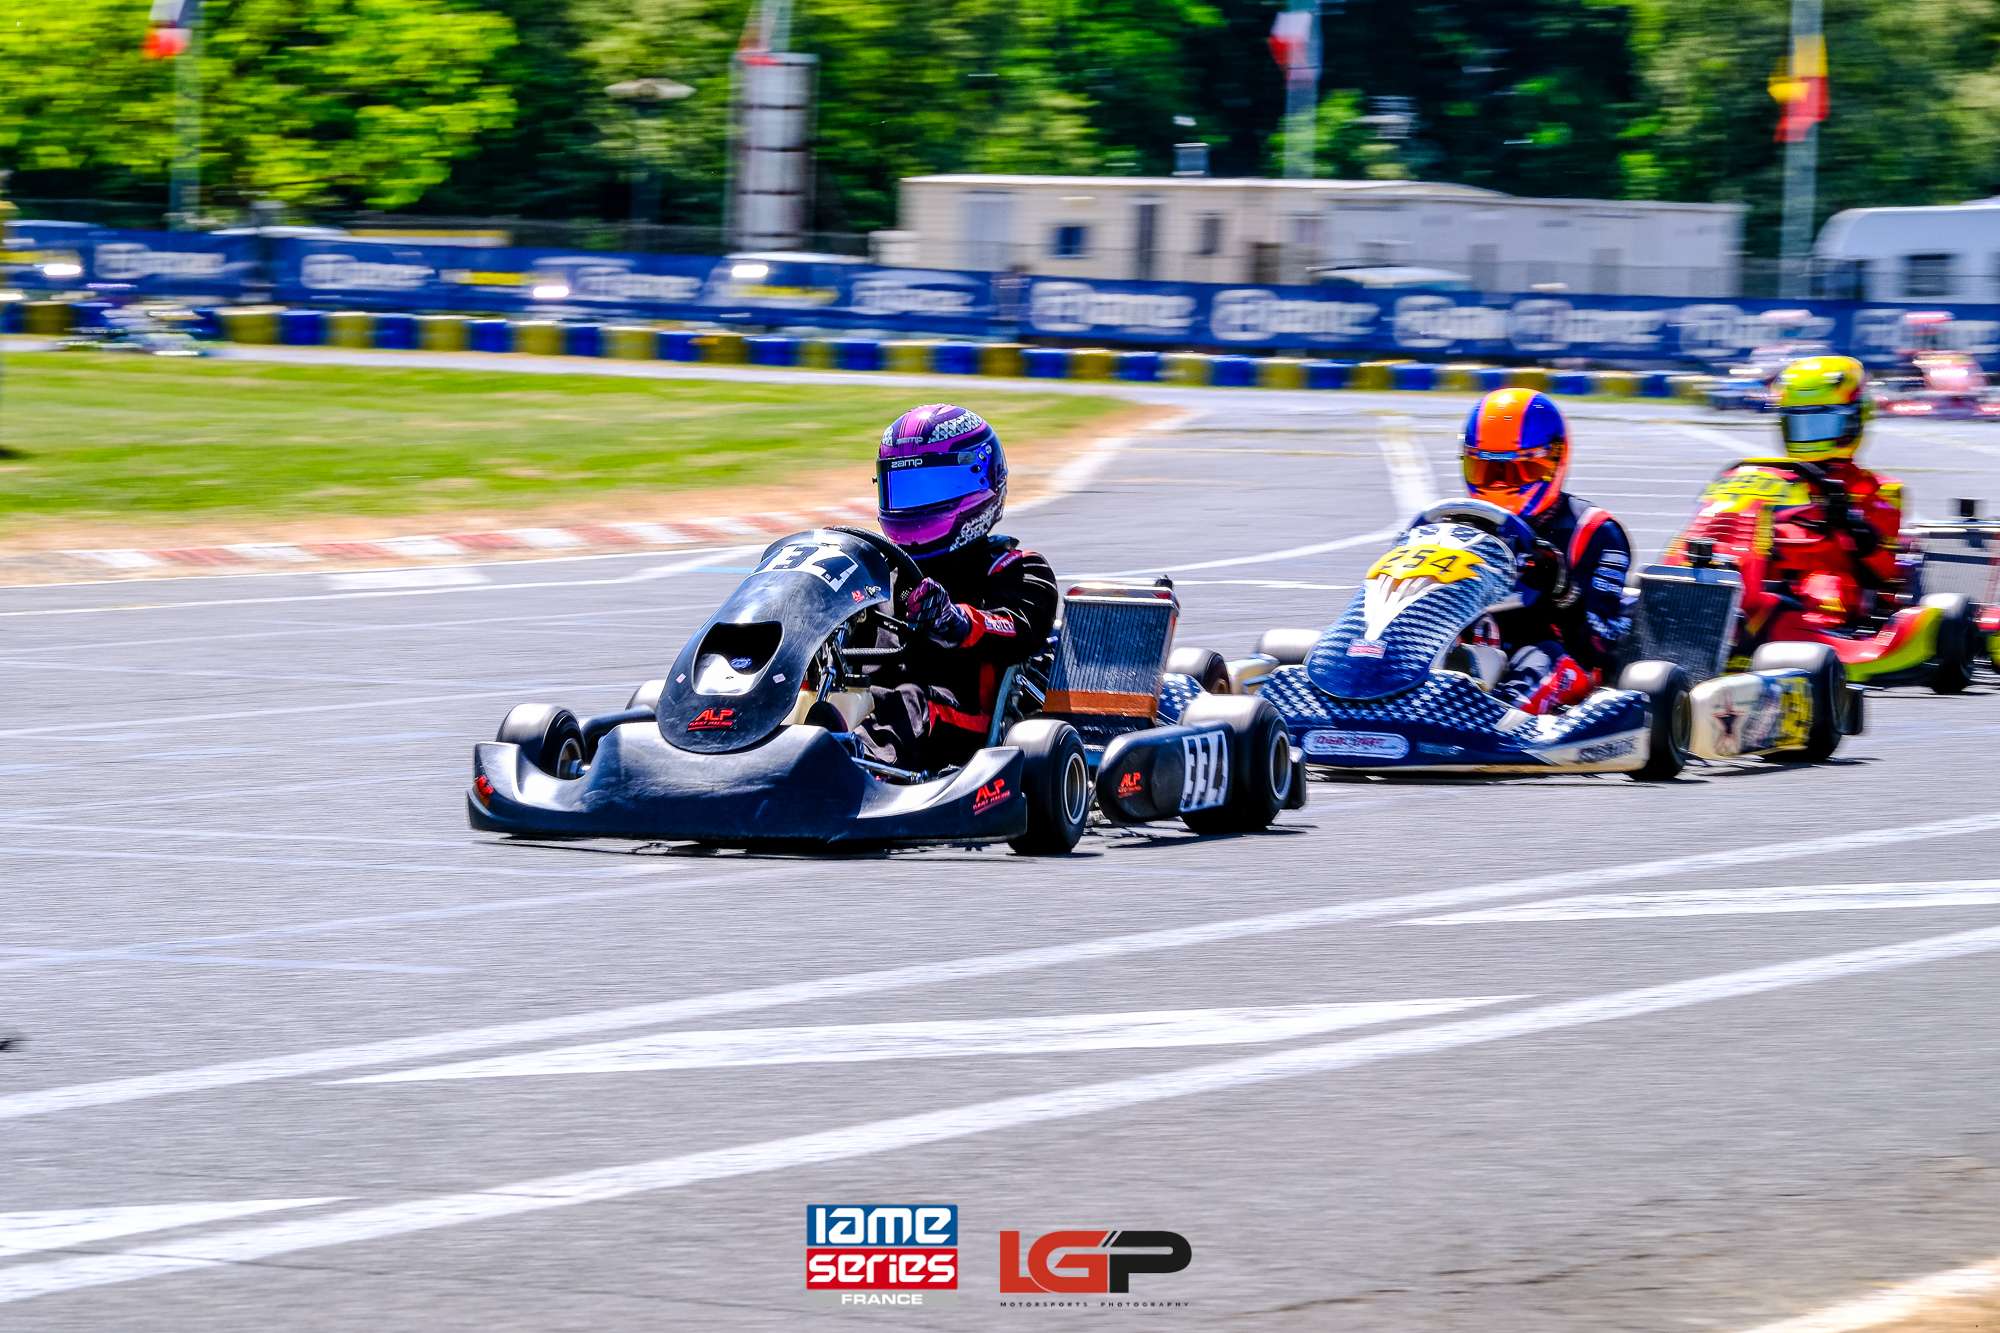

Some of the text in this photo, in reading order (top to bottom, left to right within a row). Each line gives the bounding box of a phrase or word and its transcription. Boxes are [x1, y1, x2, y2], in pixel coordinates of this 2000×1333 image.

[891, 458, 923, 469] zamp
[695, 707, 734, 721] ALP
[975, 778, 1006, 803] ALP
